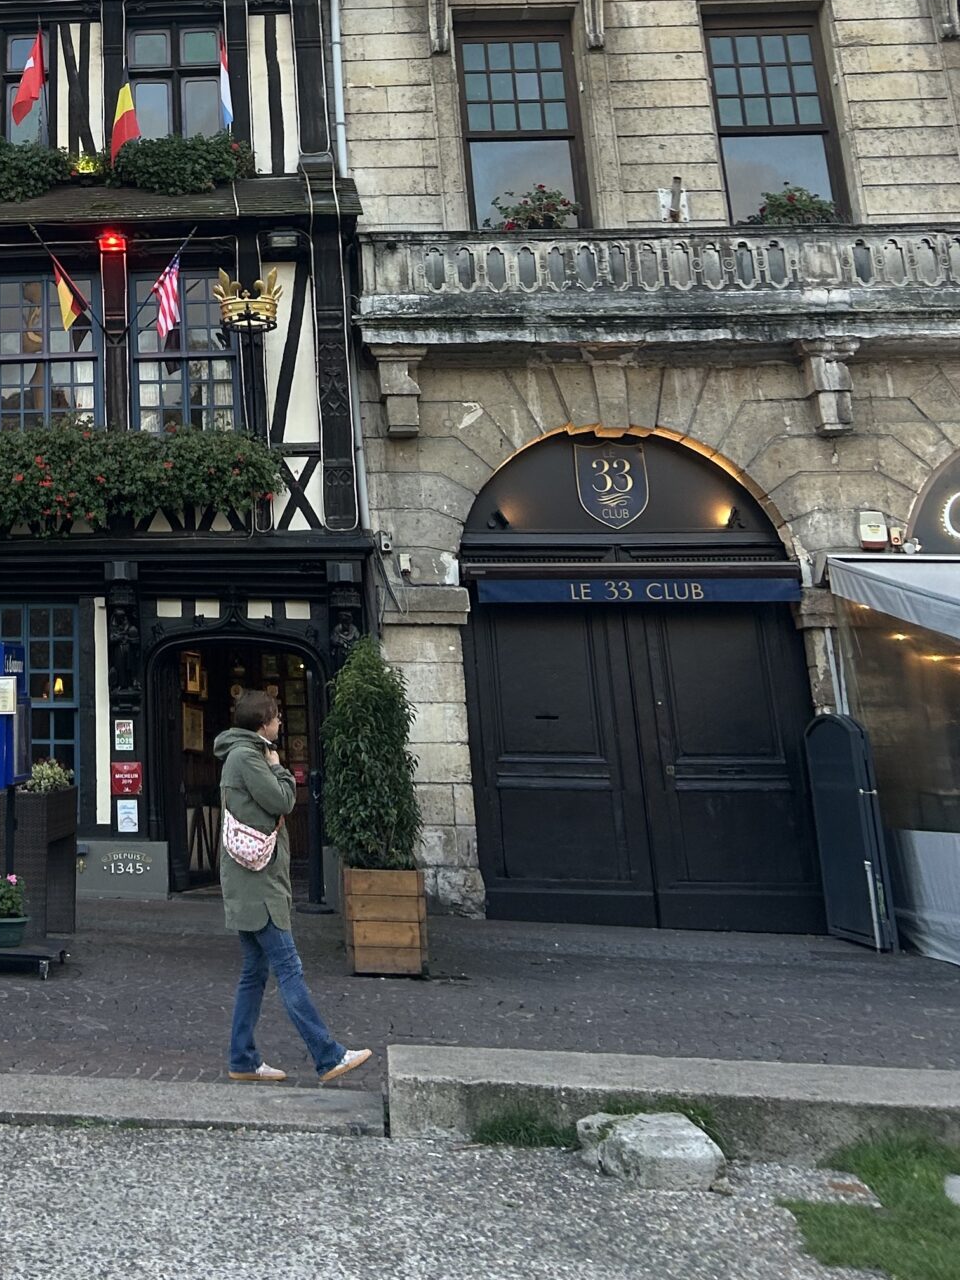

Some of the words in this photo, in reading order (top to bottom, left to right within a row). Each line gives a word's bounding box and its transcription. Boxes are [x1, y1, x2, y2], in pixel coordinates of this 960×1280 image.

[602, 448, 616, 458] LE
[591, 459, 634, 493] 33
[602, 508, 630, 519] CLUB
[570, 583, 593, 600] LE
[604, 580, 633, 600] 33
[646, 582, 705, 600] CLUB
[113, 852, 141, 861] DEPUIS
[110, 862, 144, 874] 1345
